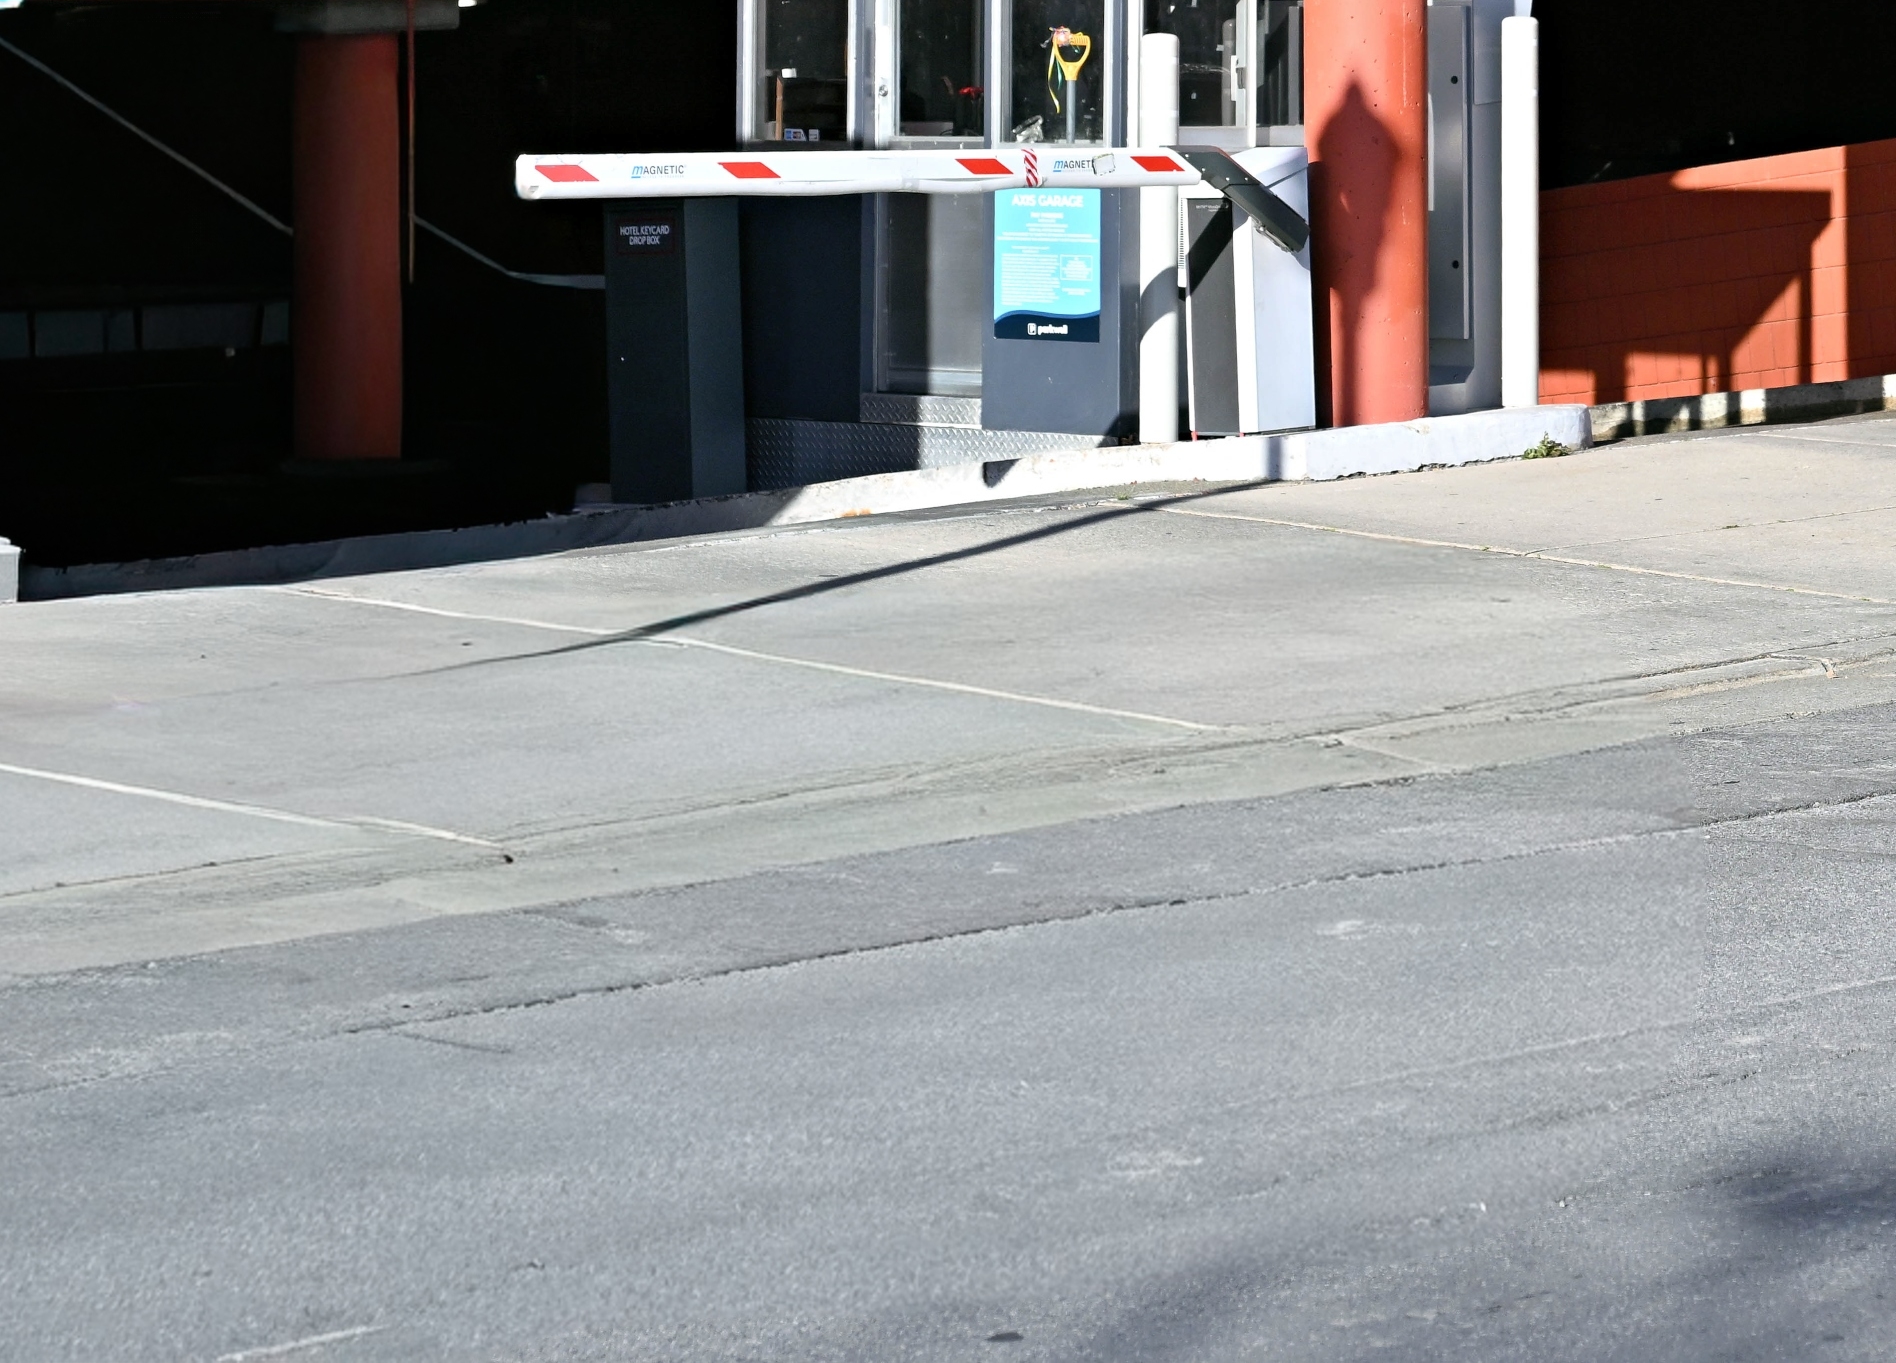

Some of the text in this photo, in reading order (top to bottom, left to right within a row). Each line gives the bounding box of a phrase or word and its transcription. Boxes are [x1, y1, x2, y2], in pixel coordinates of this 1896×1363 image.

[1011, 194, 1084, 208] AXIS GARAGE
[620, 225, 670, 236] HOTEL KEYCARD
[629, 235, 660, 245] DROP BOX
